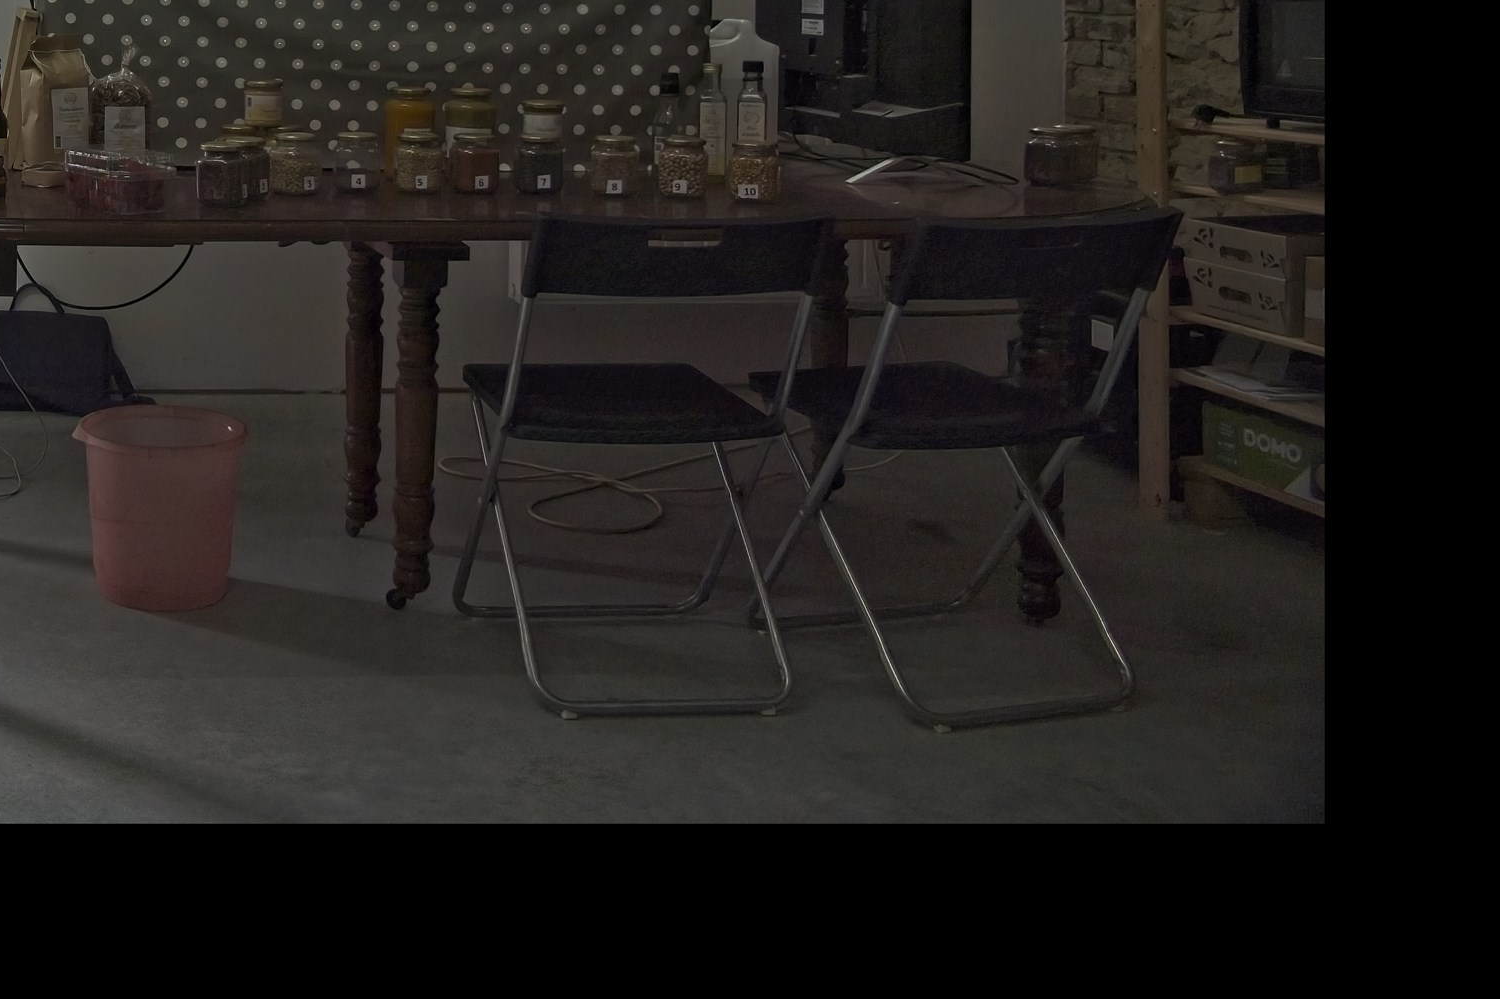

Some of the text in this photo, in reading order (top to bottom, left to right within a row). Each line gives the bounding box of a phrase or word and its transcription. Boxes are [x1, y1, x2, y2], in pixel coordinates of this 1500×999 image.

[355, 177, 362, 186] 4
[417, 179, 423, 187] 5
[478, 179, 484, 187] 6
[540, 178, 547, 186] 7
[611, 183, 618, 191] 8
[674, 183, 681, 191] 9
[744, 187, 757, 196] 10
[1243, 428, 1302, 464] DOMO
